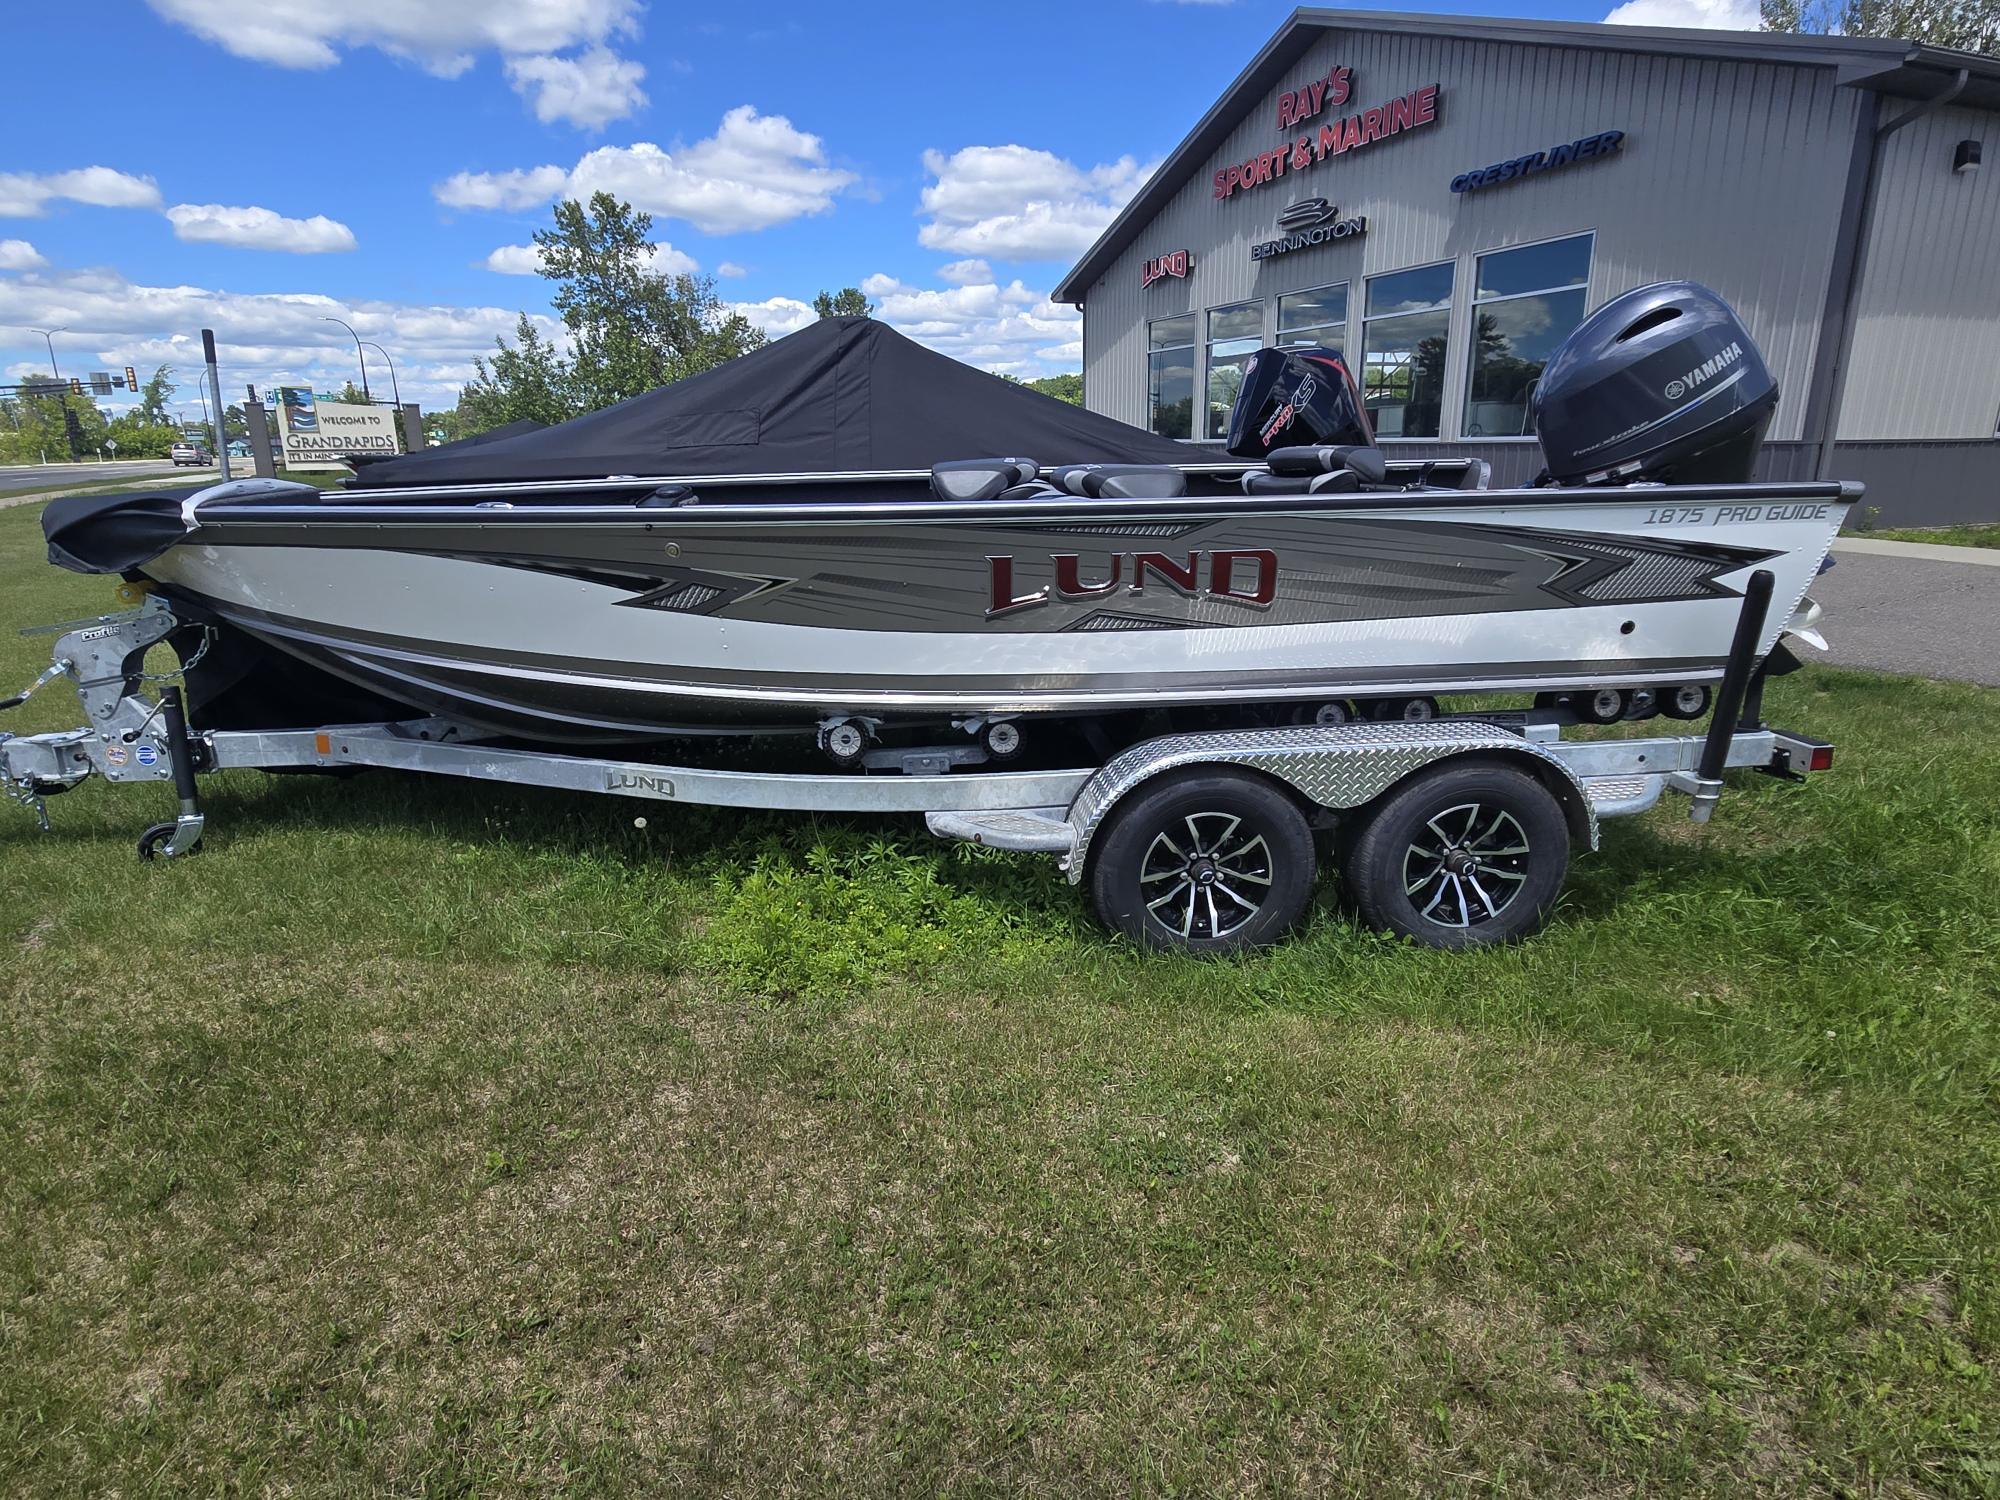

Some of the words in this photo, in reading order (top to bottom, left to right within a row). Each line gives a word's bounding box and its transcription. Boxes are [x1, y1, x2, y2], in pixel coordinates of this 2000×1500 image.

[1277, 64, 1351, 131] RAY'S
[1213, 144, 1289, 201] SPORT
[1292, 136, 1312, 170] &
[1317, 84, 1439, 162] MARINE
[1450, 130, 1625, 193] CRESTLINER
[1251, 216, 1368, 262] BENNINGTON
[1142, 249, 1188, 290] LUND
[1682, 341, 1744, 389] YAMAHA
[321, 416, 367, 426] WELCOME
[369, 416, 381, 425] TO
[1259, 402, 1283, 437] MERCURY
[1263, 404, 1294, 447] PRO
[303, 452, 313, 460] IN
[1643, 507, 1706, 524] 1875
[1712, 505, 1762, 526] PRO
[1765, 503, 1832, 521] GUIDE
[984, 548, 1279, 618] LUND
[607, 771, 676, 798] LUND
